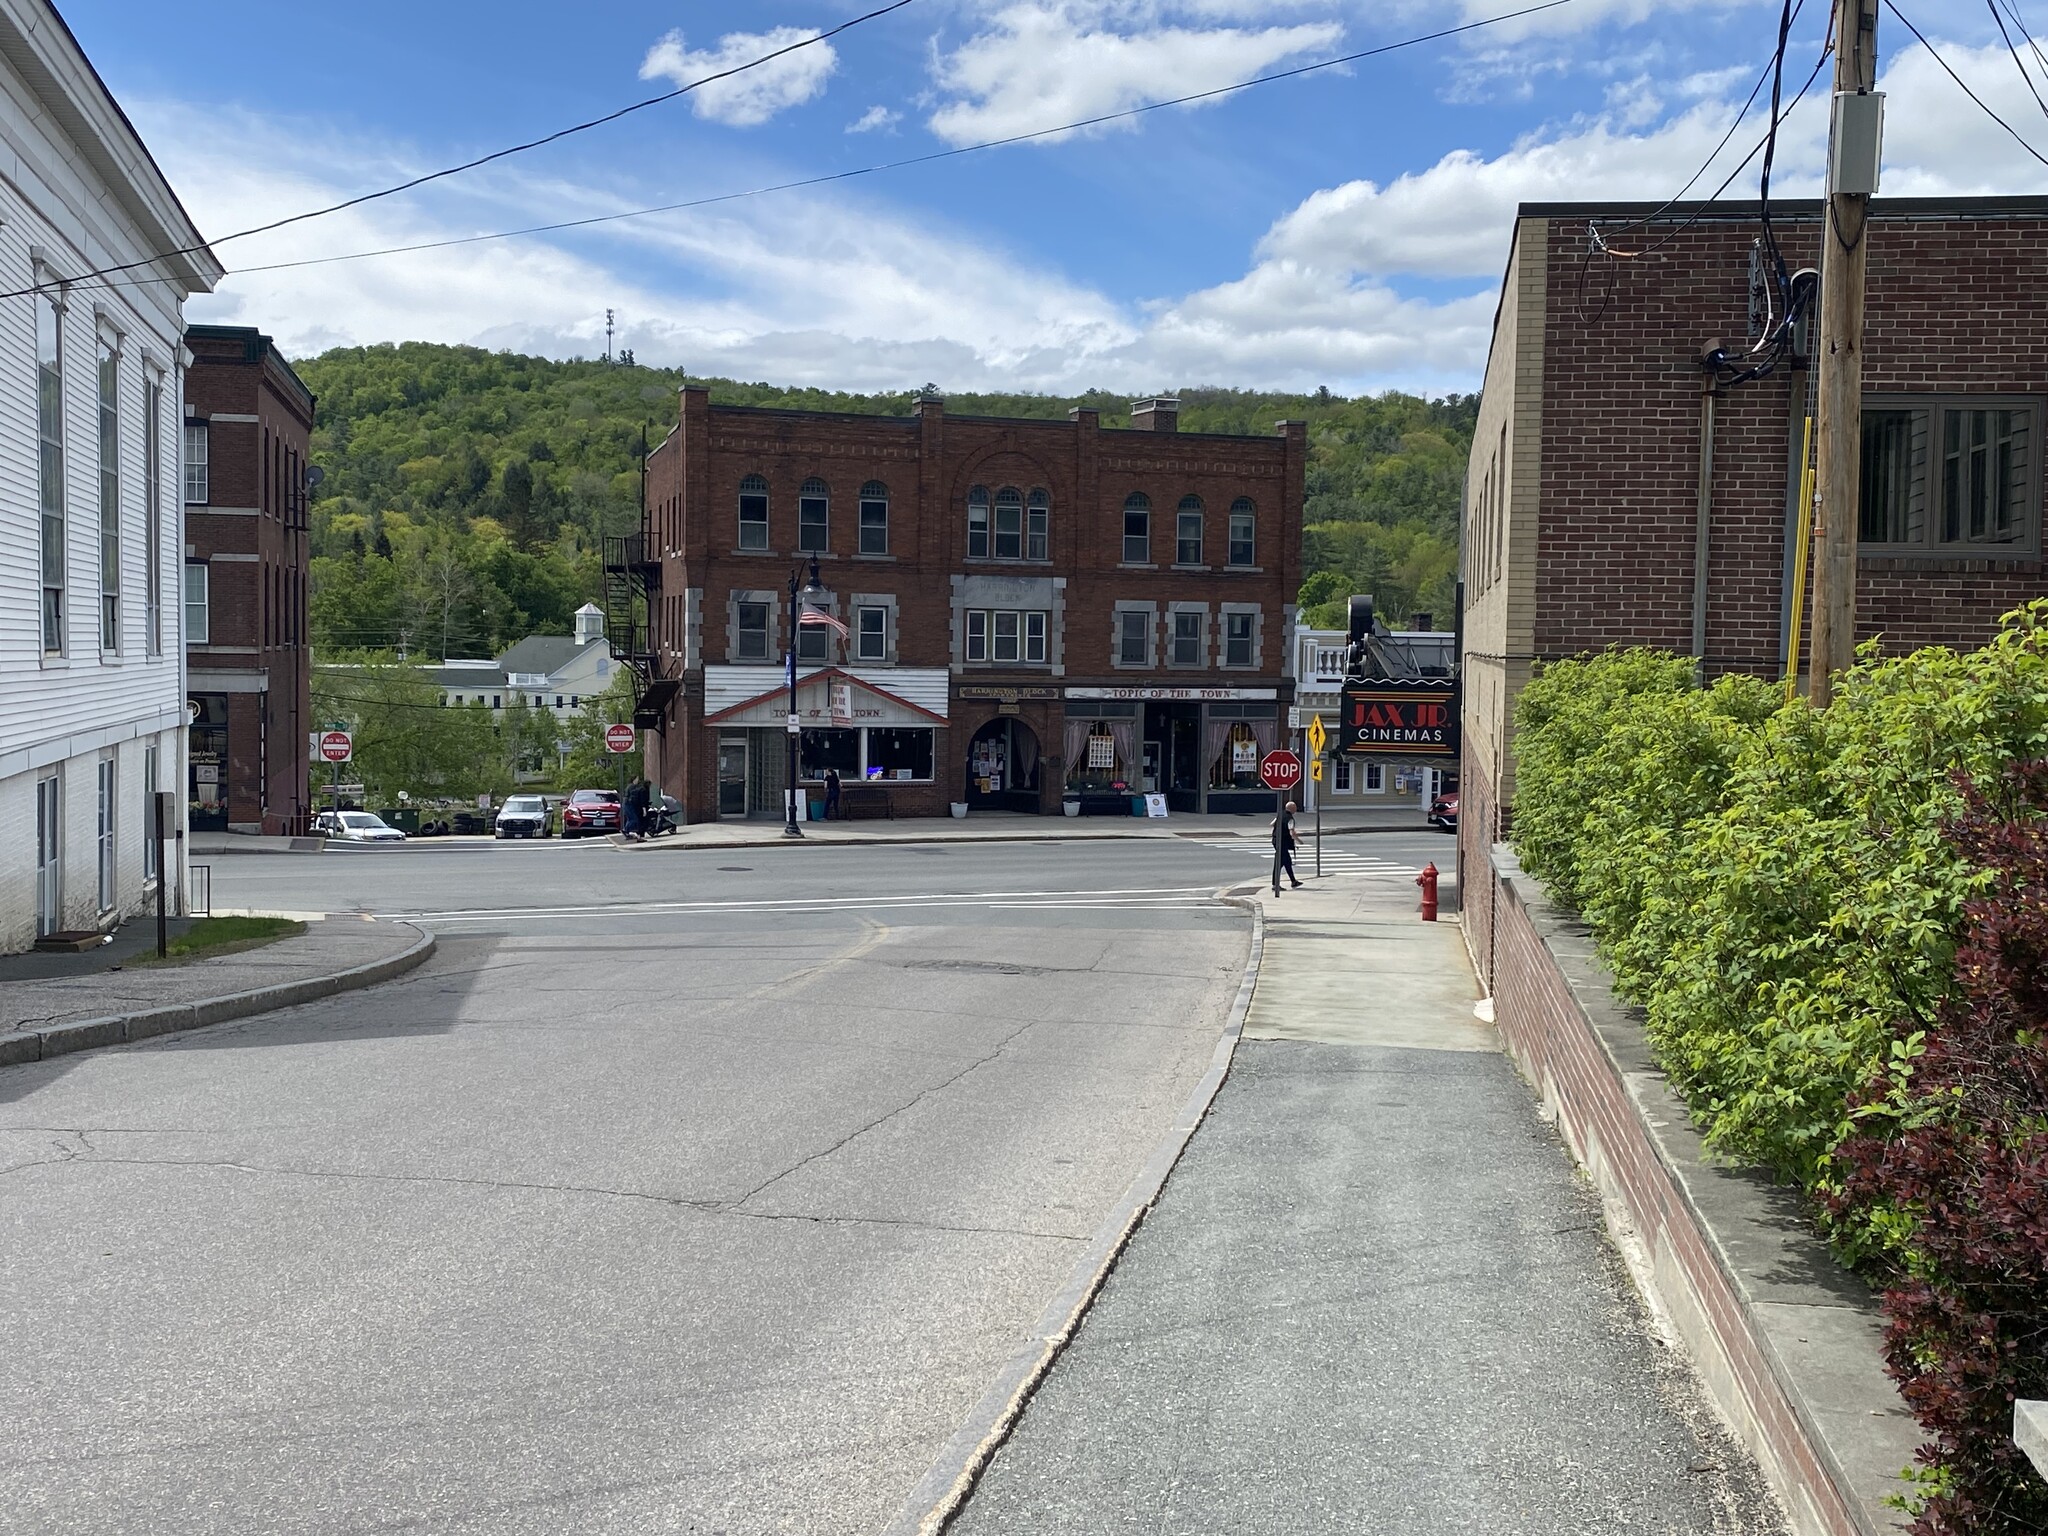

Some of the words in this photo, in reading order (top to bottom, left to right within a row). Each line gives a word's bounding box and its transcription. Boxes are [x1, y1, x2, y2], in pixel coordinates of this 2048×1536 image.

[1112, 689, 1147, 698] TOPIC
[1150, 689, 1165, 698] OF
[1170, 689, 1191, 698] THE
[1200, 689, 1231, 698] TOWN
[810, 709, 821, 717] OF
[854, 709, 880, 717] TOWN
[1348, 704, 1404, 727] JAX
[1411, 704, 1452, 728] JR.
[1358, 728, 1442, 741] CINEMAS
[1263, 762, 1299, 778] STOP
